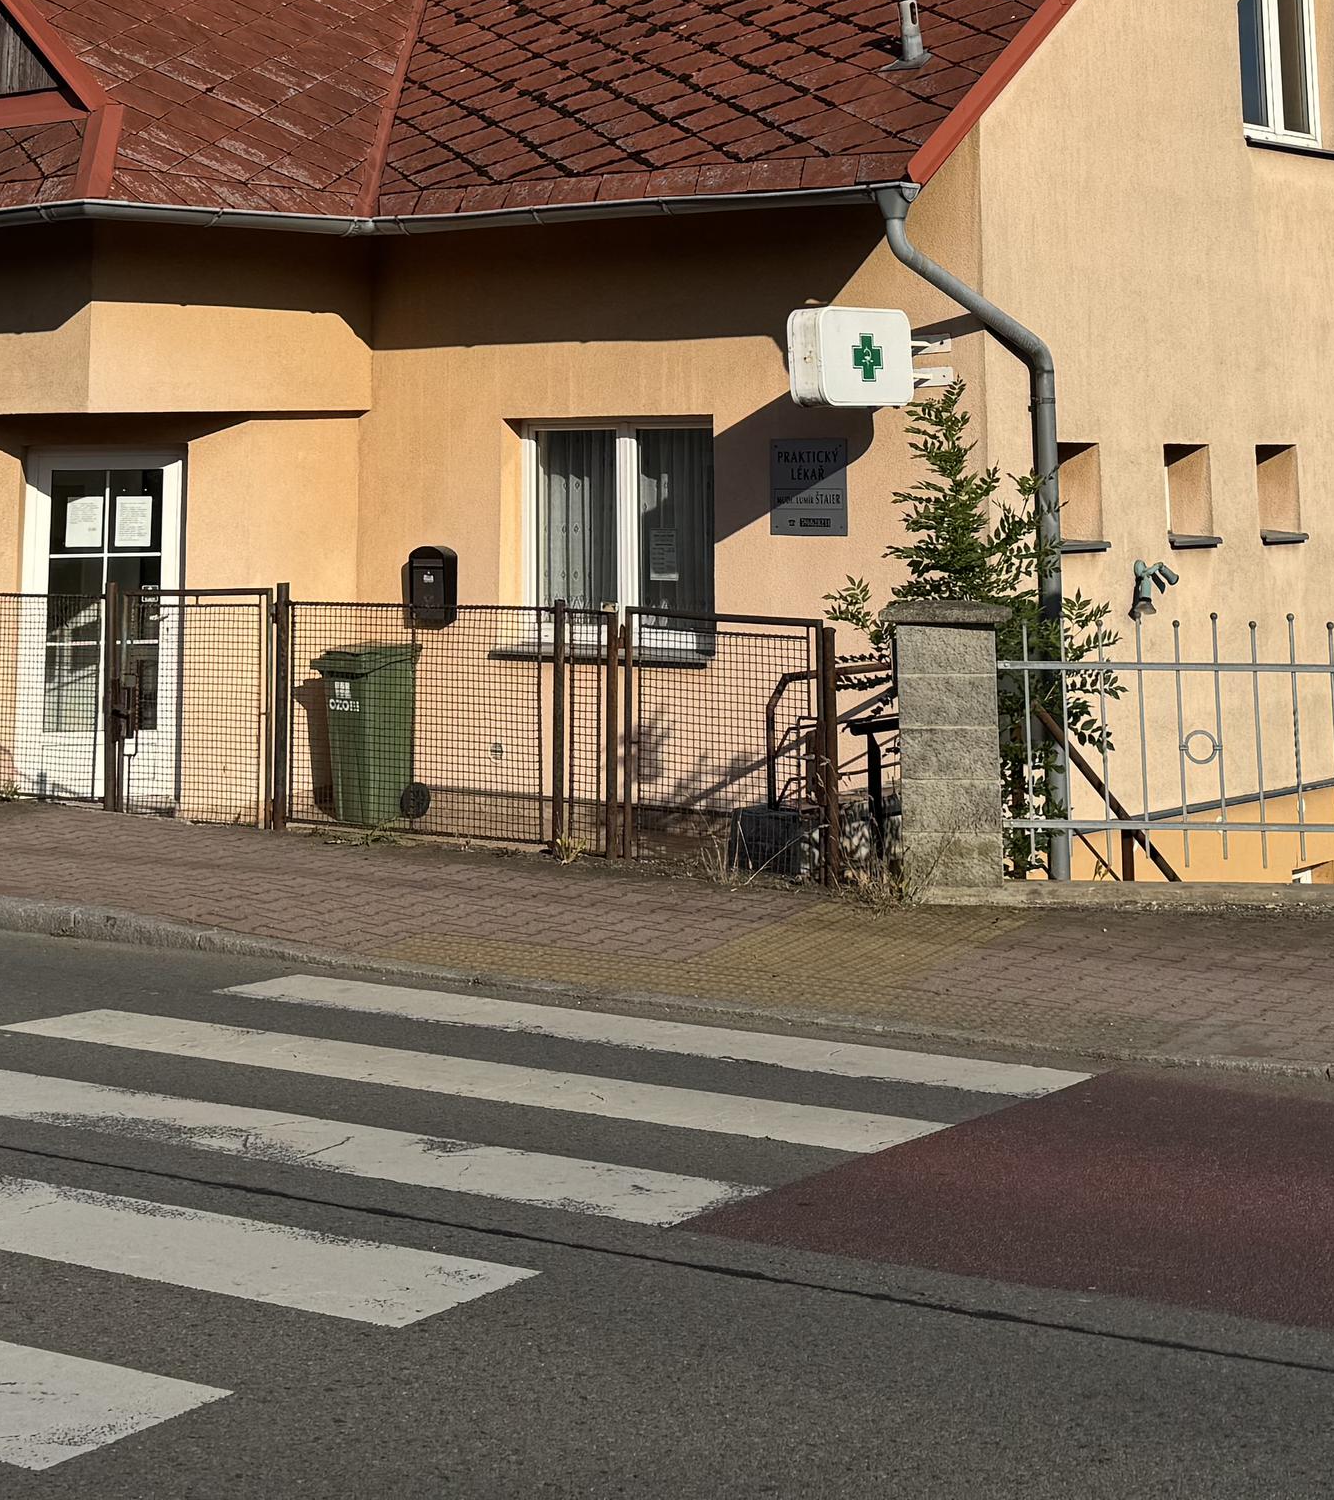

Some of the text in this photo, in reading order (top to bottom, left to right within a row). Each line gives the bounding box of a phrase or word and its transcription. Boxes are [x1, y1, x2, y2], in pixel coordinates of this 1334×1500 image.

[777, 447, 838, 463] PRAKTICKÝ
[791, 465, 825, 481] LÉKAŘ
[815, 491, 841, 504] ŠTAIER
